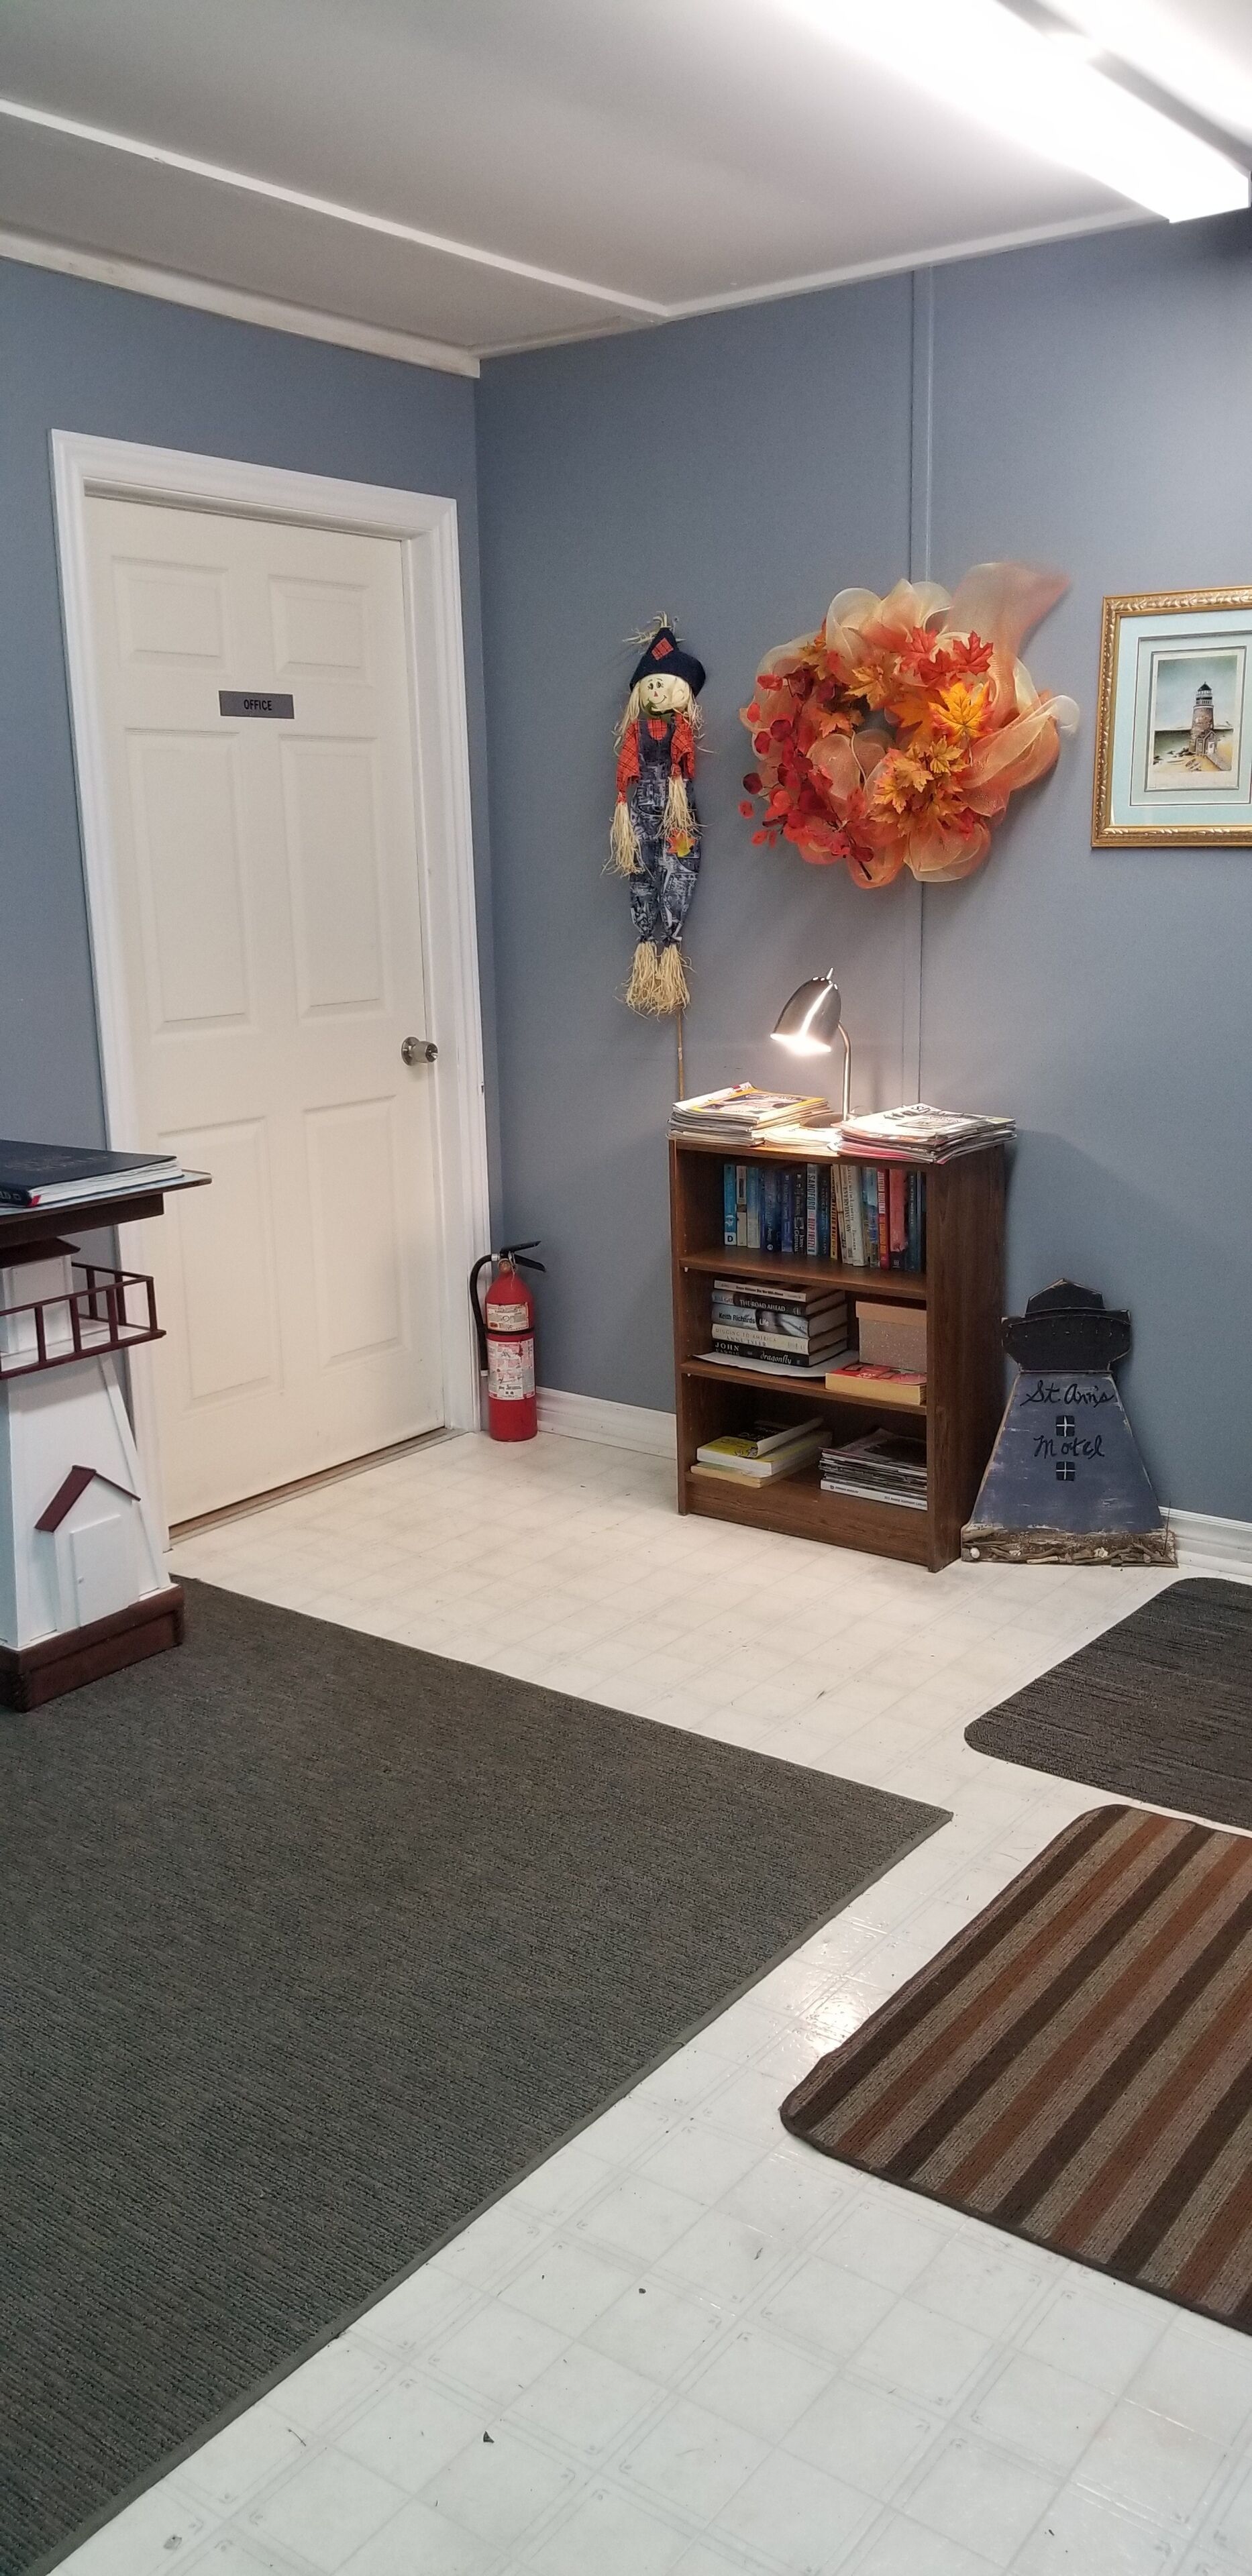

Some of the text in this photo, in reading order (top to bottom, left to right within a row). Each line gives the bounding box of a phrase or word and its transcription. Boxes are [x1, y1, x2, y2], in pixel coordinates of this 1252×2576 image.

[244, 699, 272, 711] OFFICE
[719, 1311, 756, 1324] Keith Richards
[715, 1342, 740, 1352] JOHN
[760, 1351, 792, 1364] dragonfly
[1020, 1379, 1115, 1408] St. Ann's
[1033, 1434, 1105, 1460] Motel
